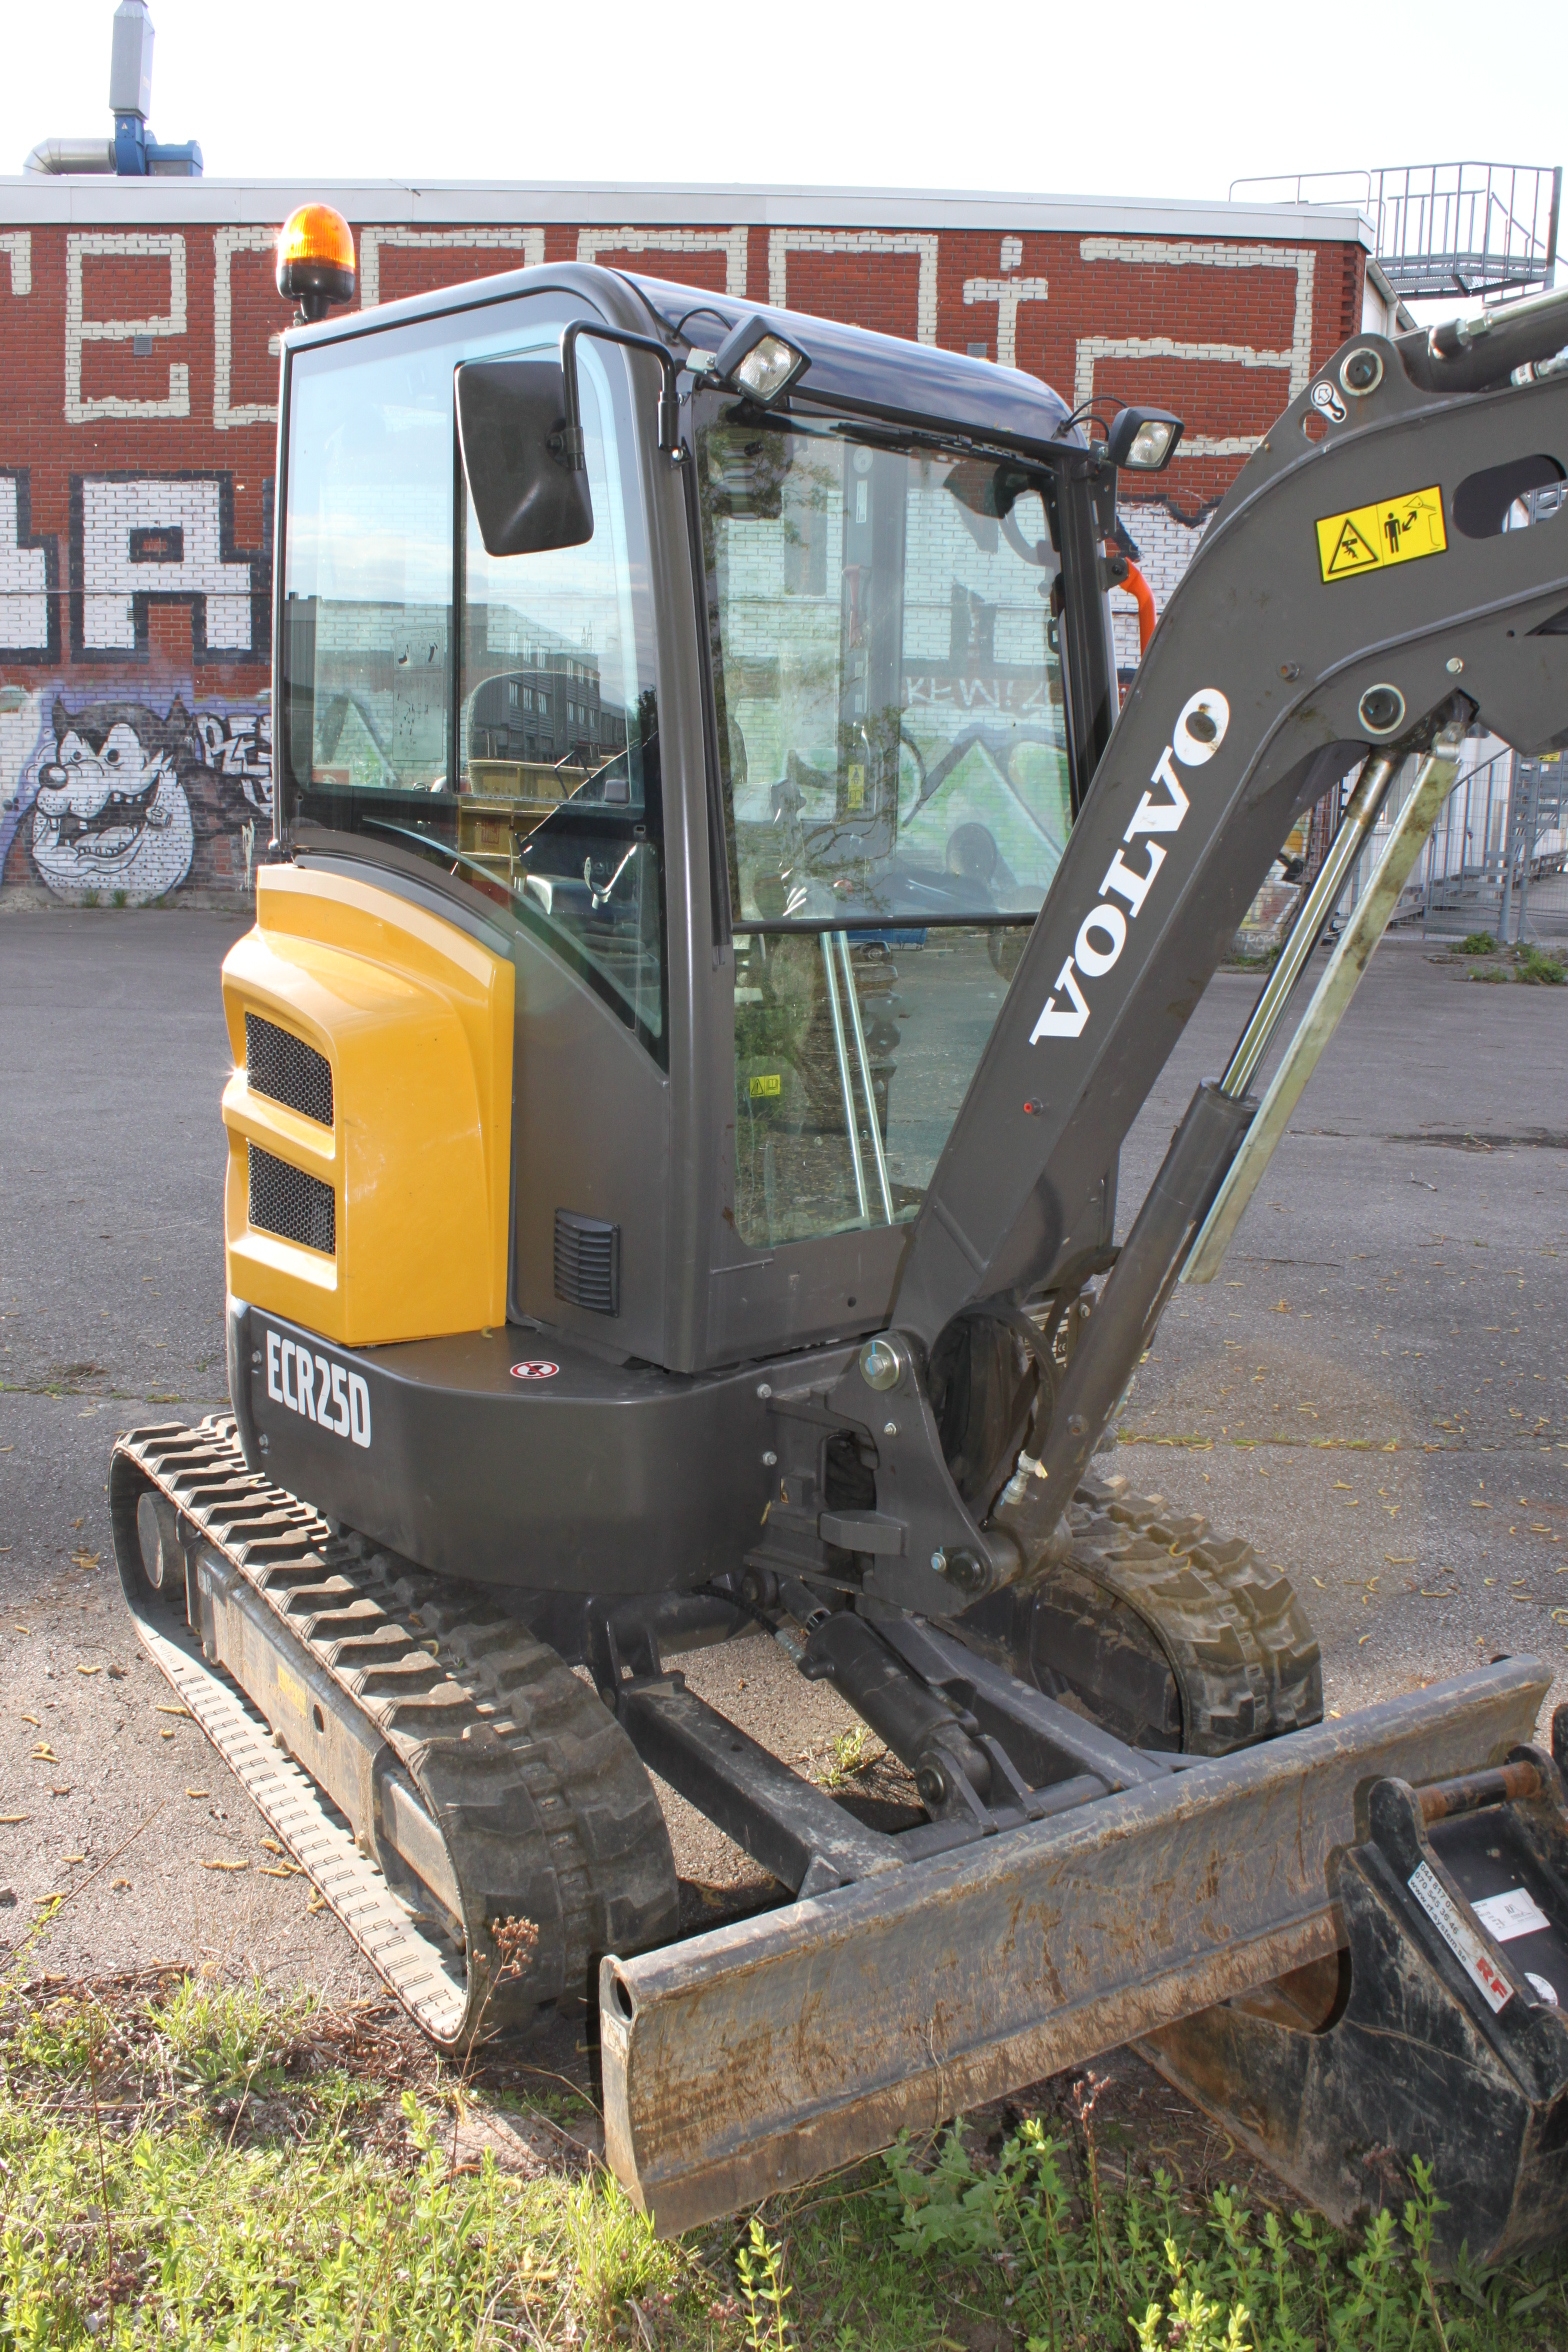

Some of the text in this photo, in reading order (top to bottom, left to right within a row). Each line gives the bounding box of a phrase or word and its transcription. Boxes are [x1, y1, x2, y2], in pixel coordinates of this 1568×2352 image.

[1029, 689, 1230, 1045] VOLVO
[266, 1329, 371, 1449] ECR25D
[1415, 1871, 1428, 1889] 070
[1440, 1907, 1450, 1921] 36
[1449, 1922, 1459, 1935] 46
[1420, 1864, 1433, 1882] 044
[1432, 1881, 1446, 1899] 817
[1410, 1880, 1467, 1962] www.rf-system.se
[1476, 1956, 1508, 1998] RF
